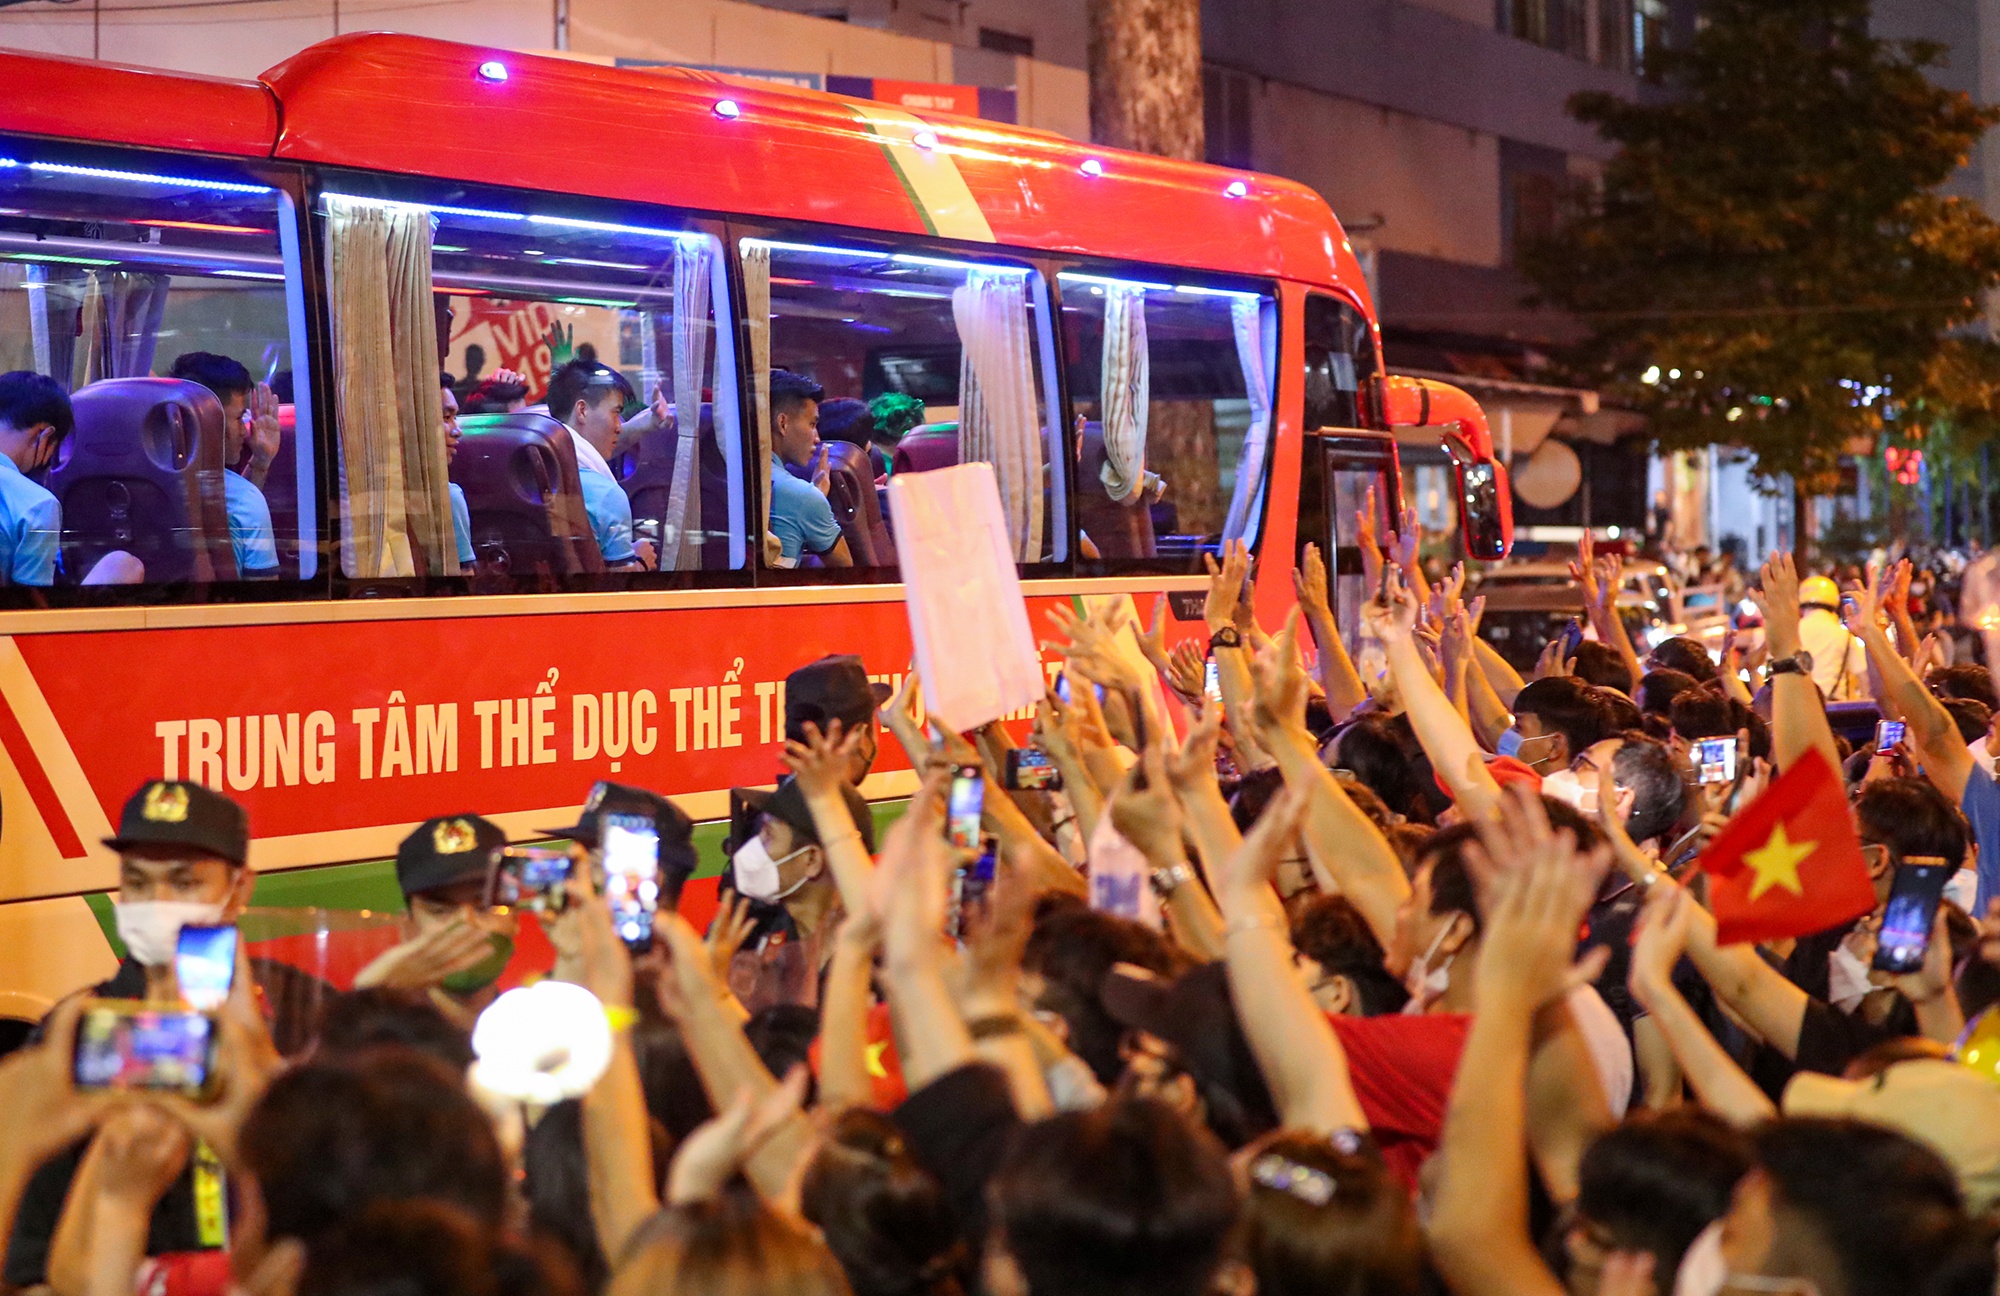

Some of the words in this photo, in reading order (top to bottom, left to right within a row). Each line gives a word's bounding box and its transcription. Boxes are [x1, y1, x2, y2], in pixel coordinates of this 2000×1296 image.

[155, 709, 336, 792] TRUNG
[352, 690, 458, 780] TÂM
[473, 667, 560, 769] THỂ
[572, 688, 658, 773] DỤC
[669, 656, 745, 752] THỂ
